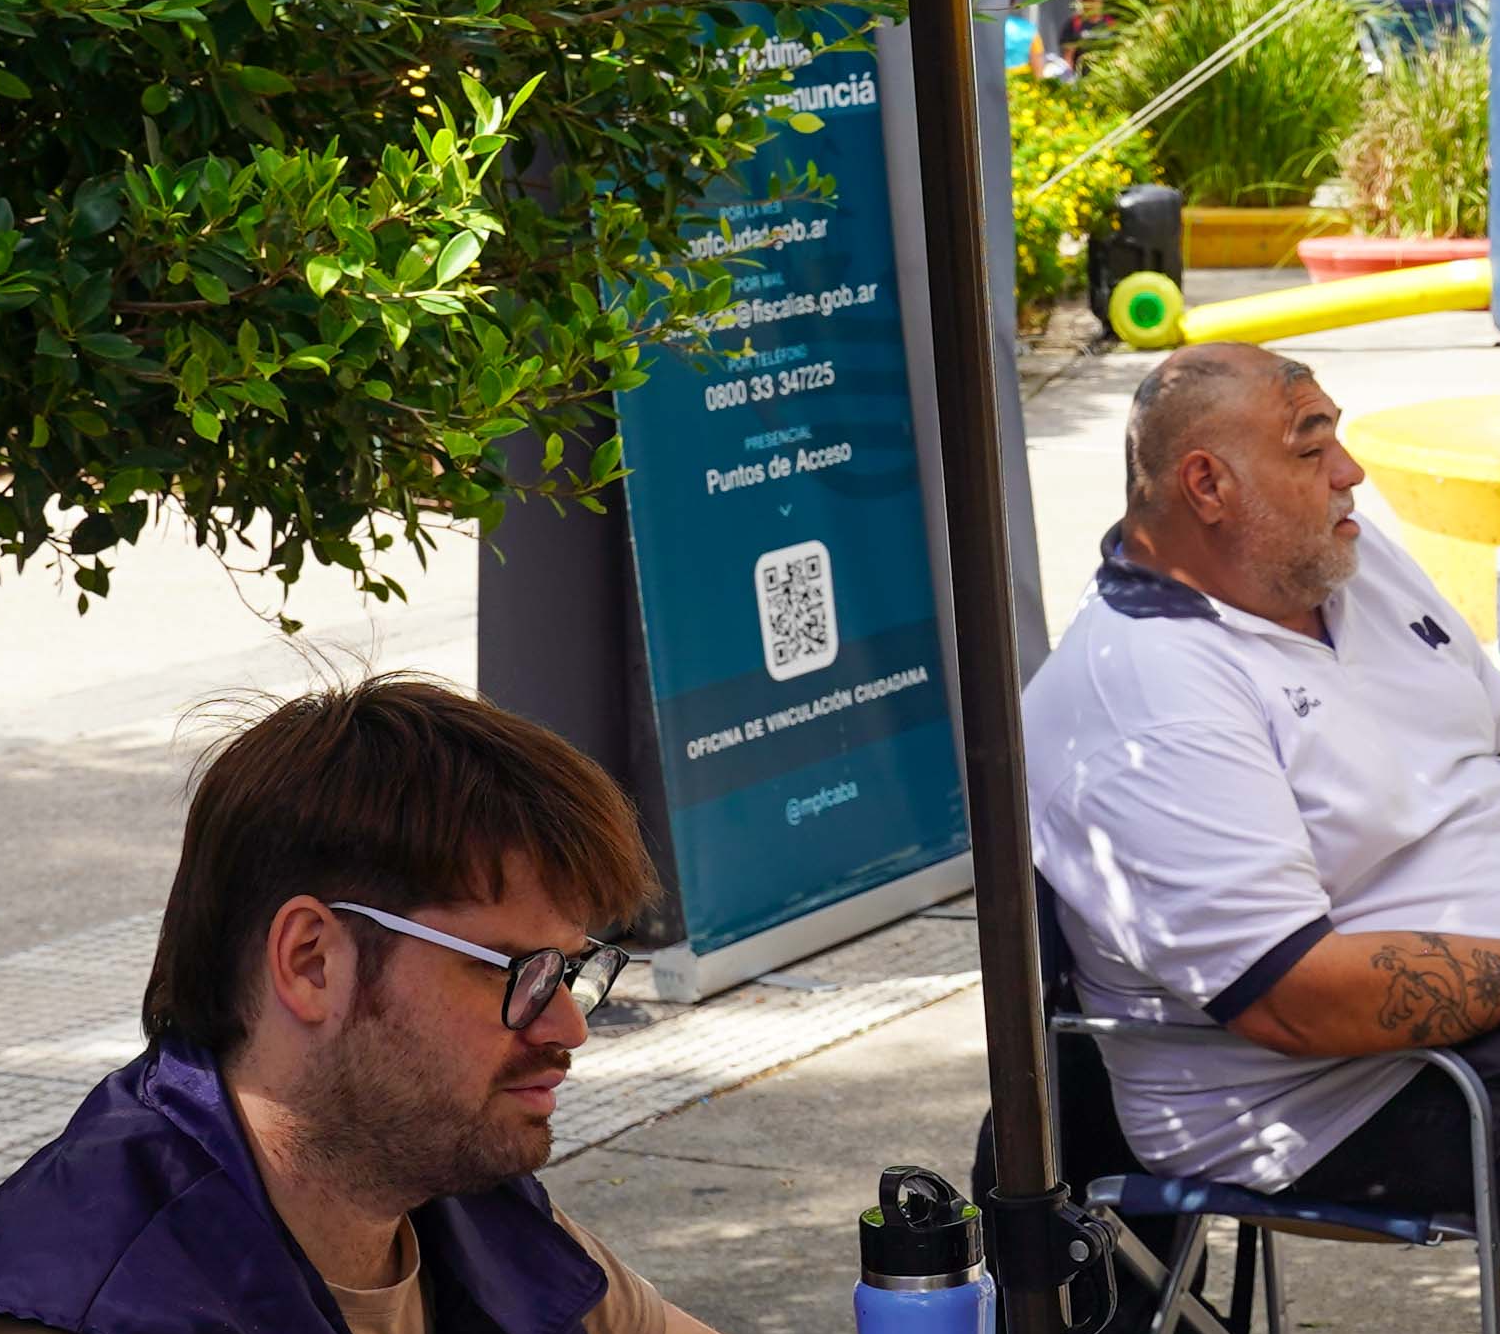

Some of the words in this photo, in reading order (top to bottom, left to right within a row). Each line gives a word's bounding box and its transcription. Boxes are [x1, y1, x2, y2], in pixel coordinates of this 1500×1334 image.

[705, 379, 748, 412] 0800
[750, 373, 775, 402] 33
[705, 464, 766, 495] Puntos
[768, 454, 792, 480] de
[795, 442, 853, 473] Acceso
[686, 725, 745, 761] OFICINA
[744, 717, 766, 741] DE
[764, 687, 853, 734] VINCULACIÓN
[853, 665, 929, 704] CIUDADANA
